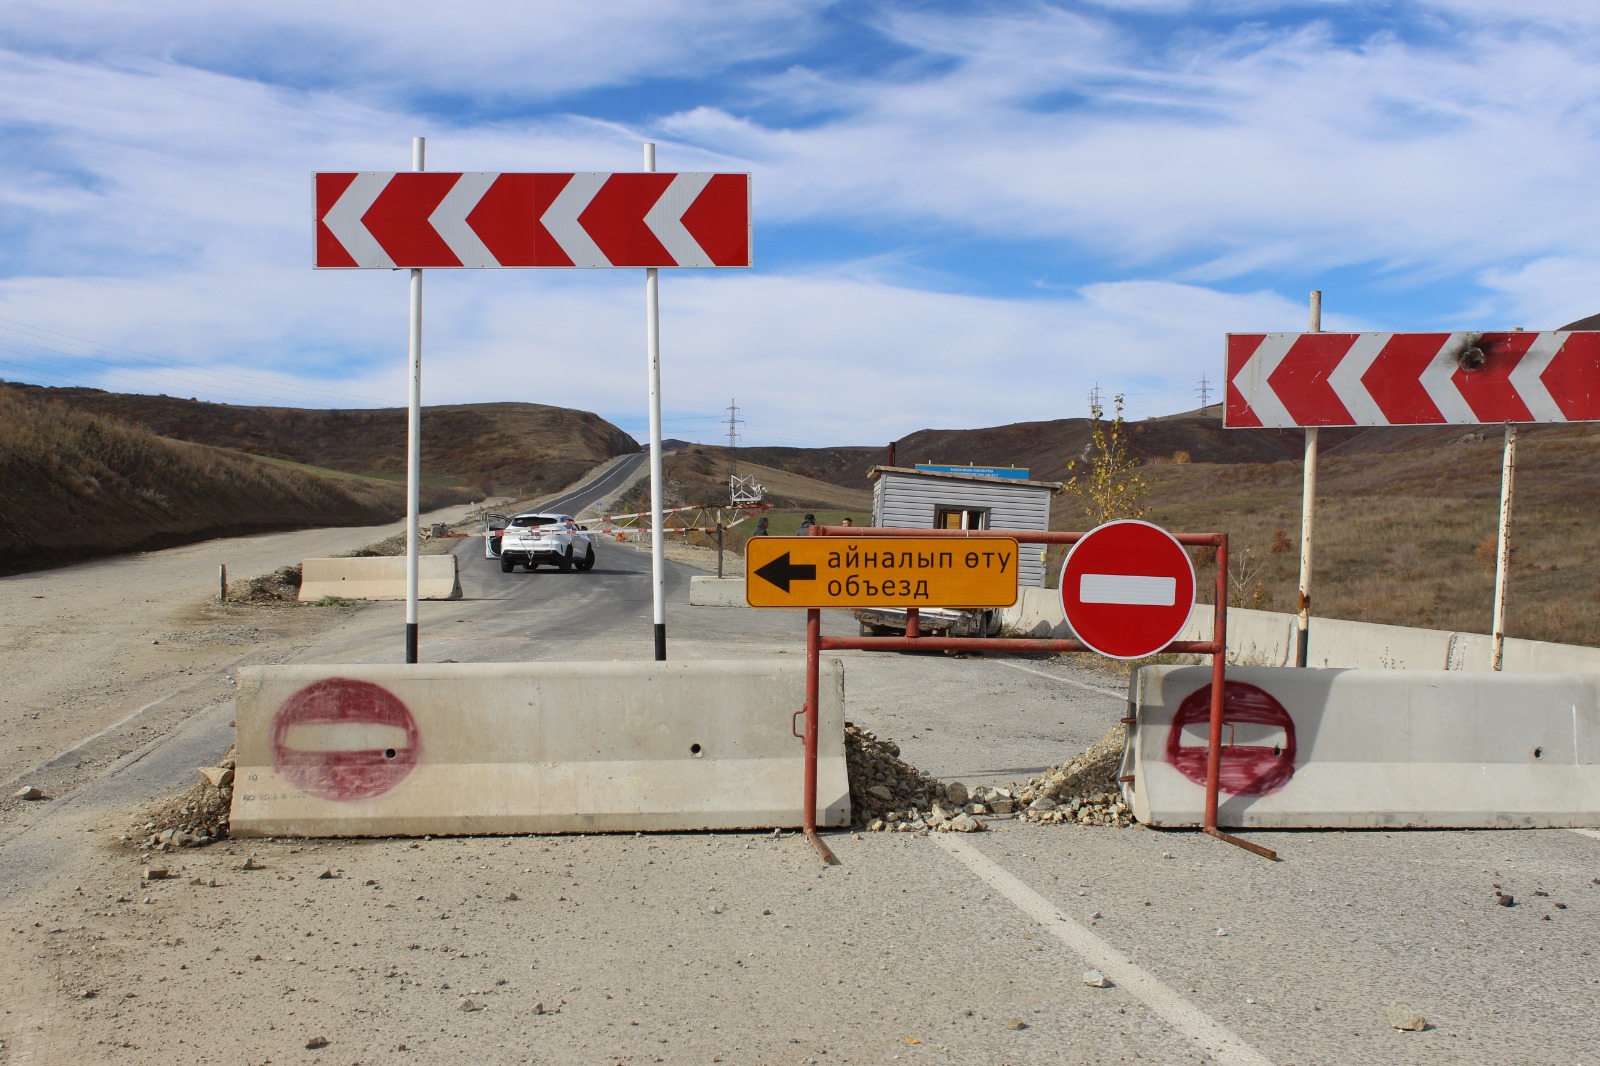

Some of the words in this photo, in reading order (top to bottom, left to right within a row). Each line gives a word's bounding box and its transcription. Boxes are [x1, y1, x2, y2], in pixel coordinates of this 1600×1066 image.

[827, 545, 952, 569] айналып
[965, 551, 1011, 574] өту
[827, 574, 929, 600] объезд
